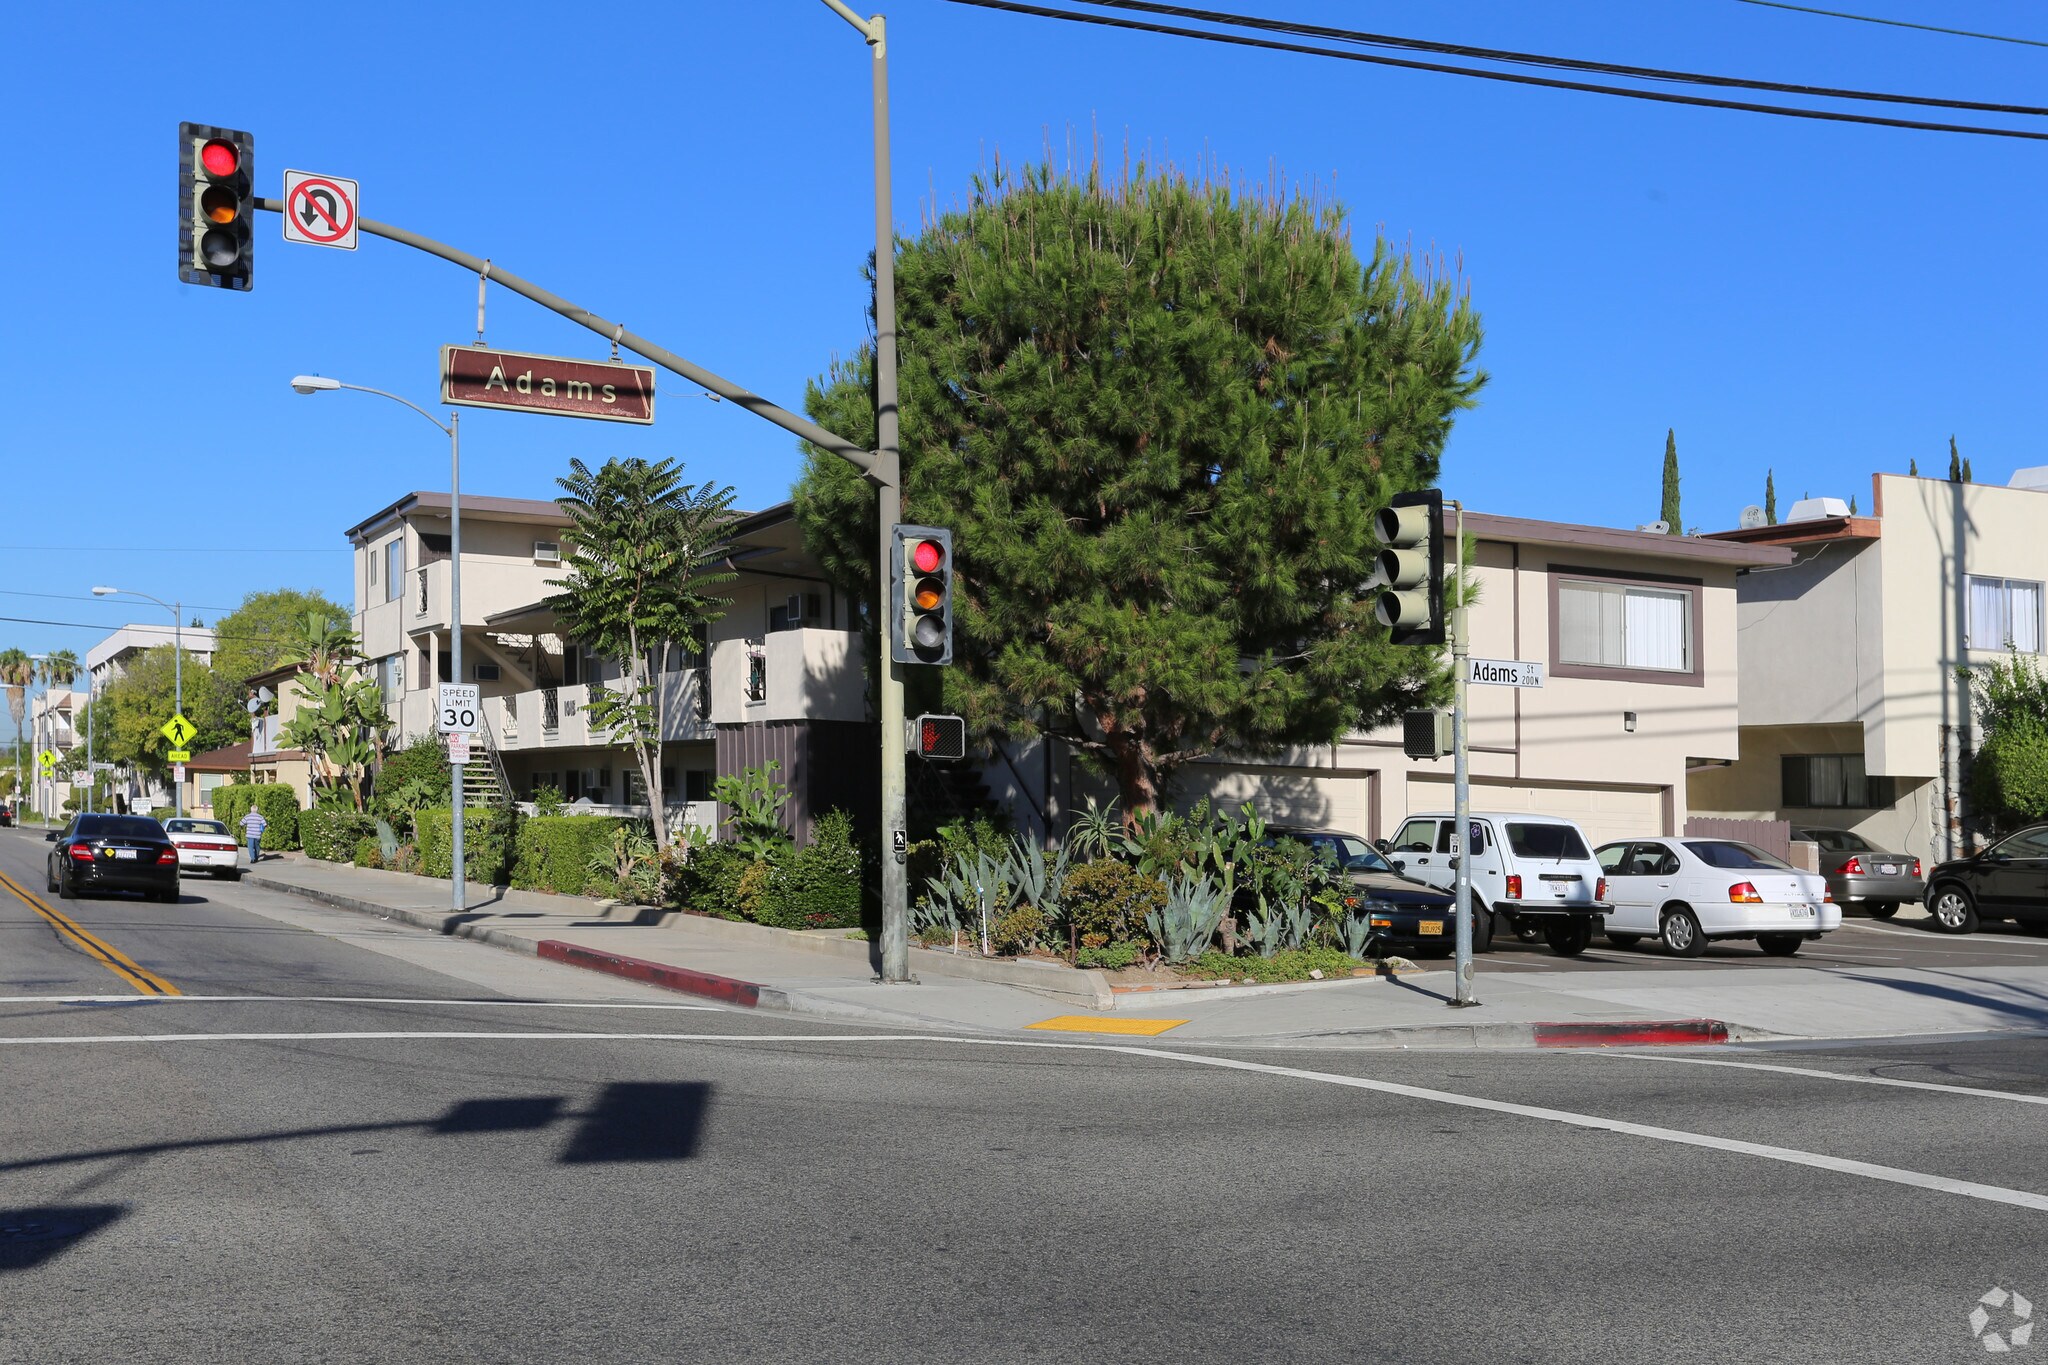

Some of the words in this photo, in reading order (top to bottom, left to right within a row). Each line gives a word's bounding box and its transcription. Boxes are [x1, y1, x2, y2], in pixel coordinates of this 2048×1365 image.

[484, 365, 618, 404] Adams
[1473, 661, 1518, 683] Adams
[1526, 664, 1534, 674] St
[442, 688, 476, 698] SPEED
[446, 699, 471, 707] LIMIT
[443, 708, 475, 727] 30
[450, 733, 459, 743] NO
